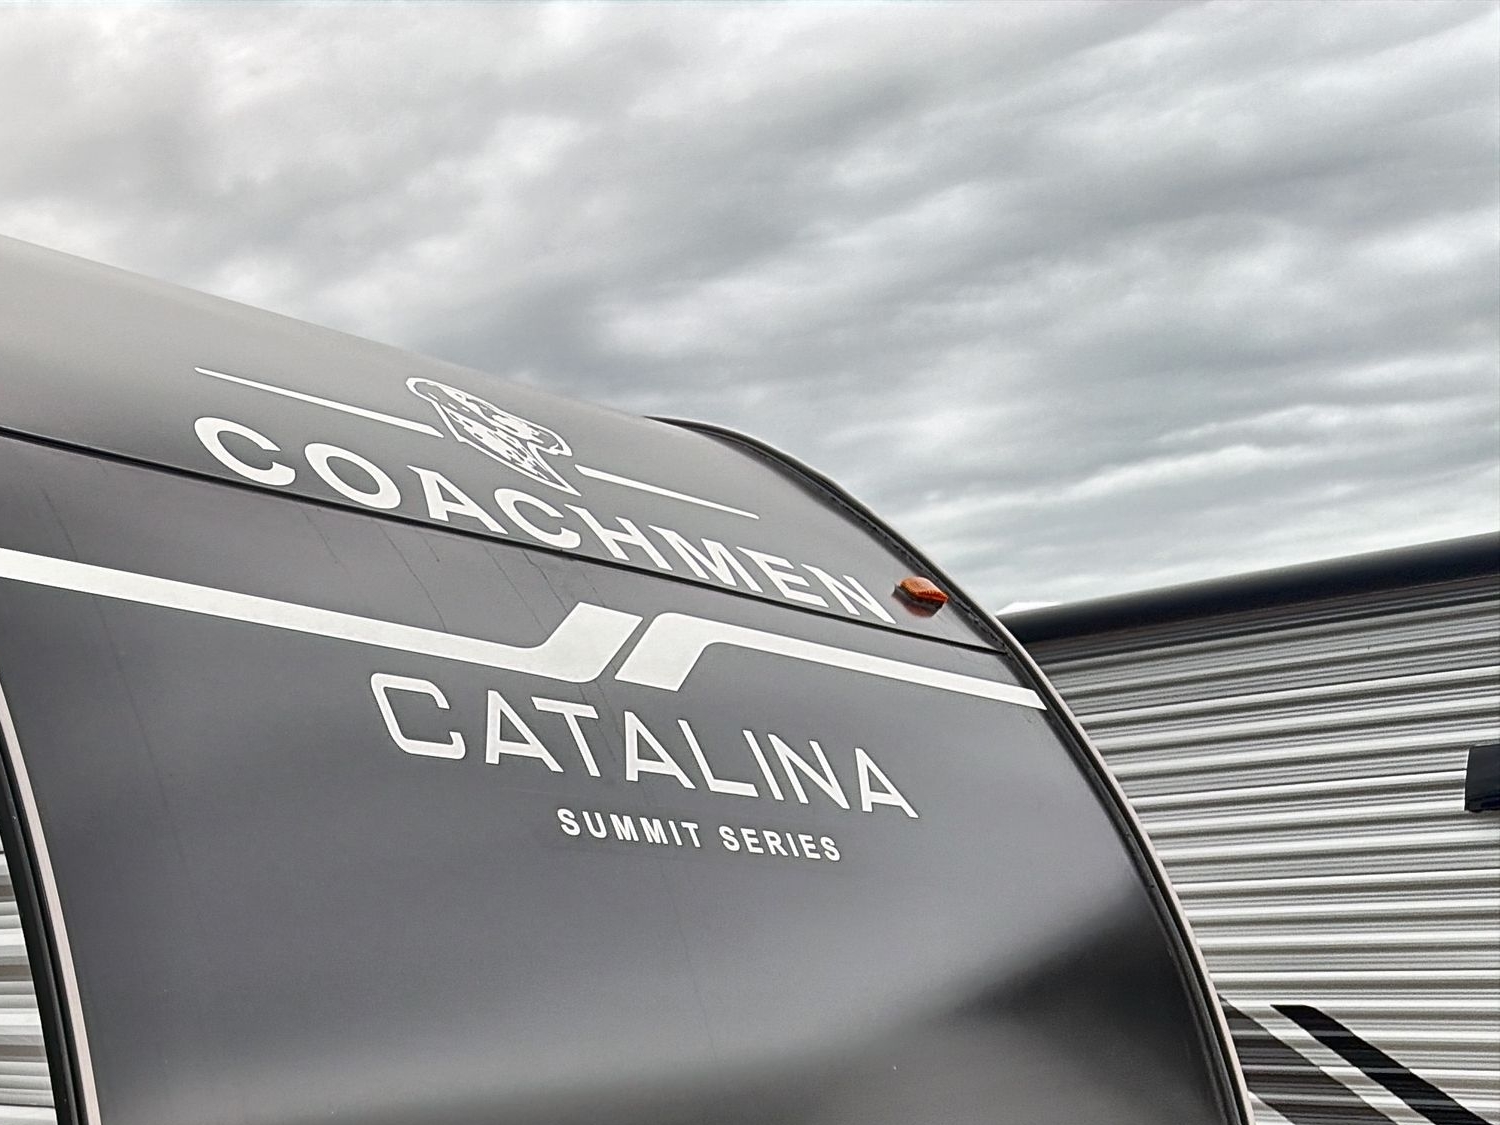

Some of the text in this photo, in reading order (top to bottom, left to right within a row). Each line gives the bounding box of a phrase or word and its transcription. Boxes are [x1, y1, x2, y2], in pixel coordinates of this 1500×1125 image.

[194, 416, 896, 624] COACHMEN
[370, 672, 919, 818] CATALINA
[556, 808, 841, 861] SUMMIT SERIES
